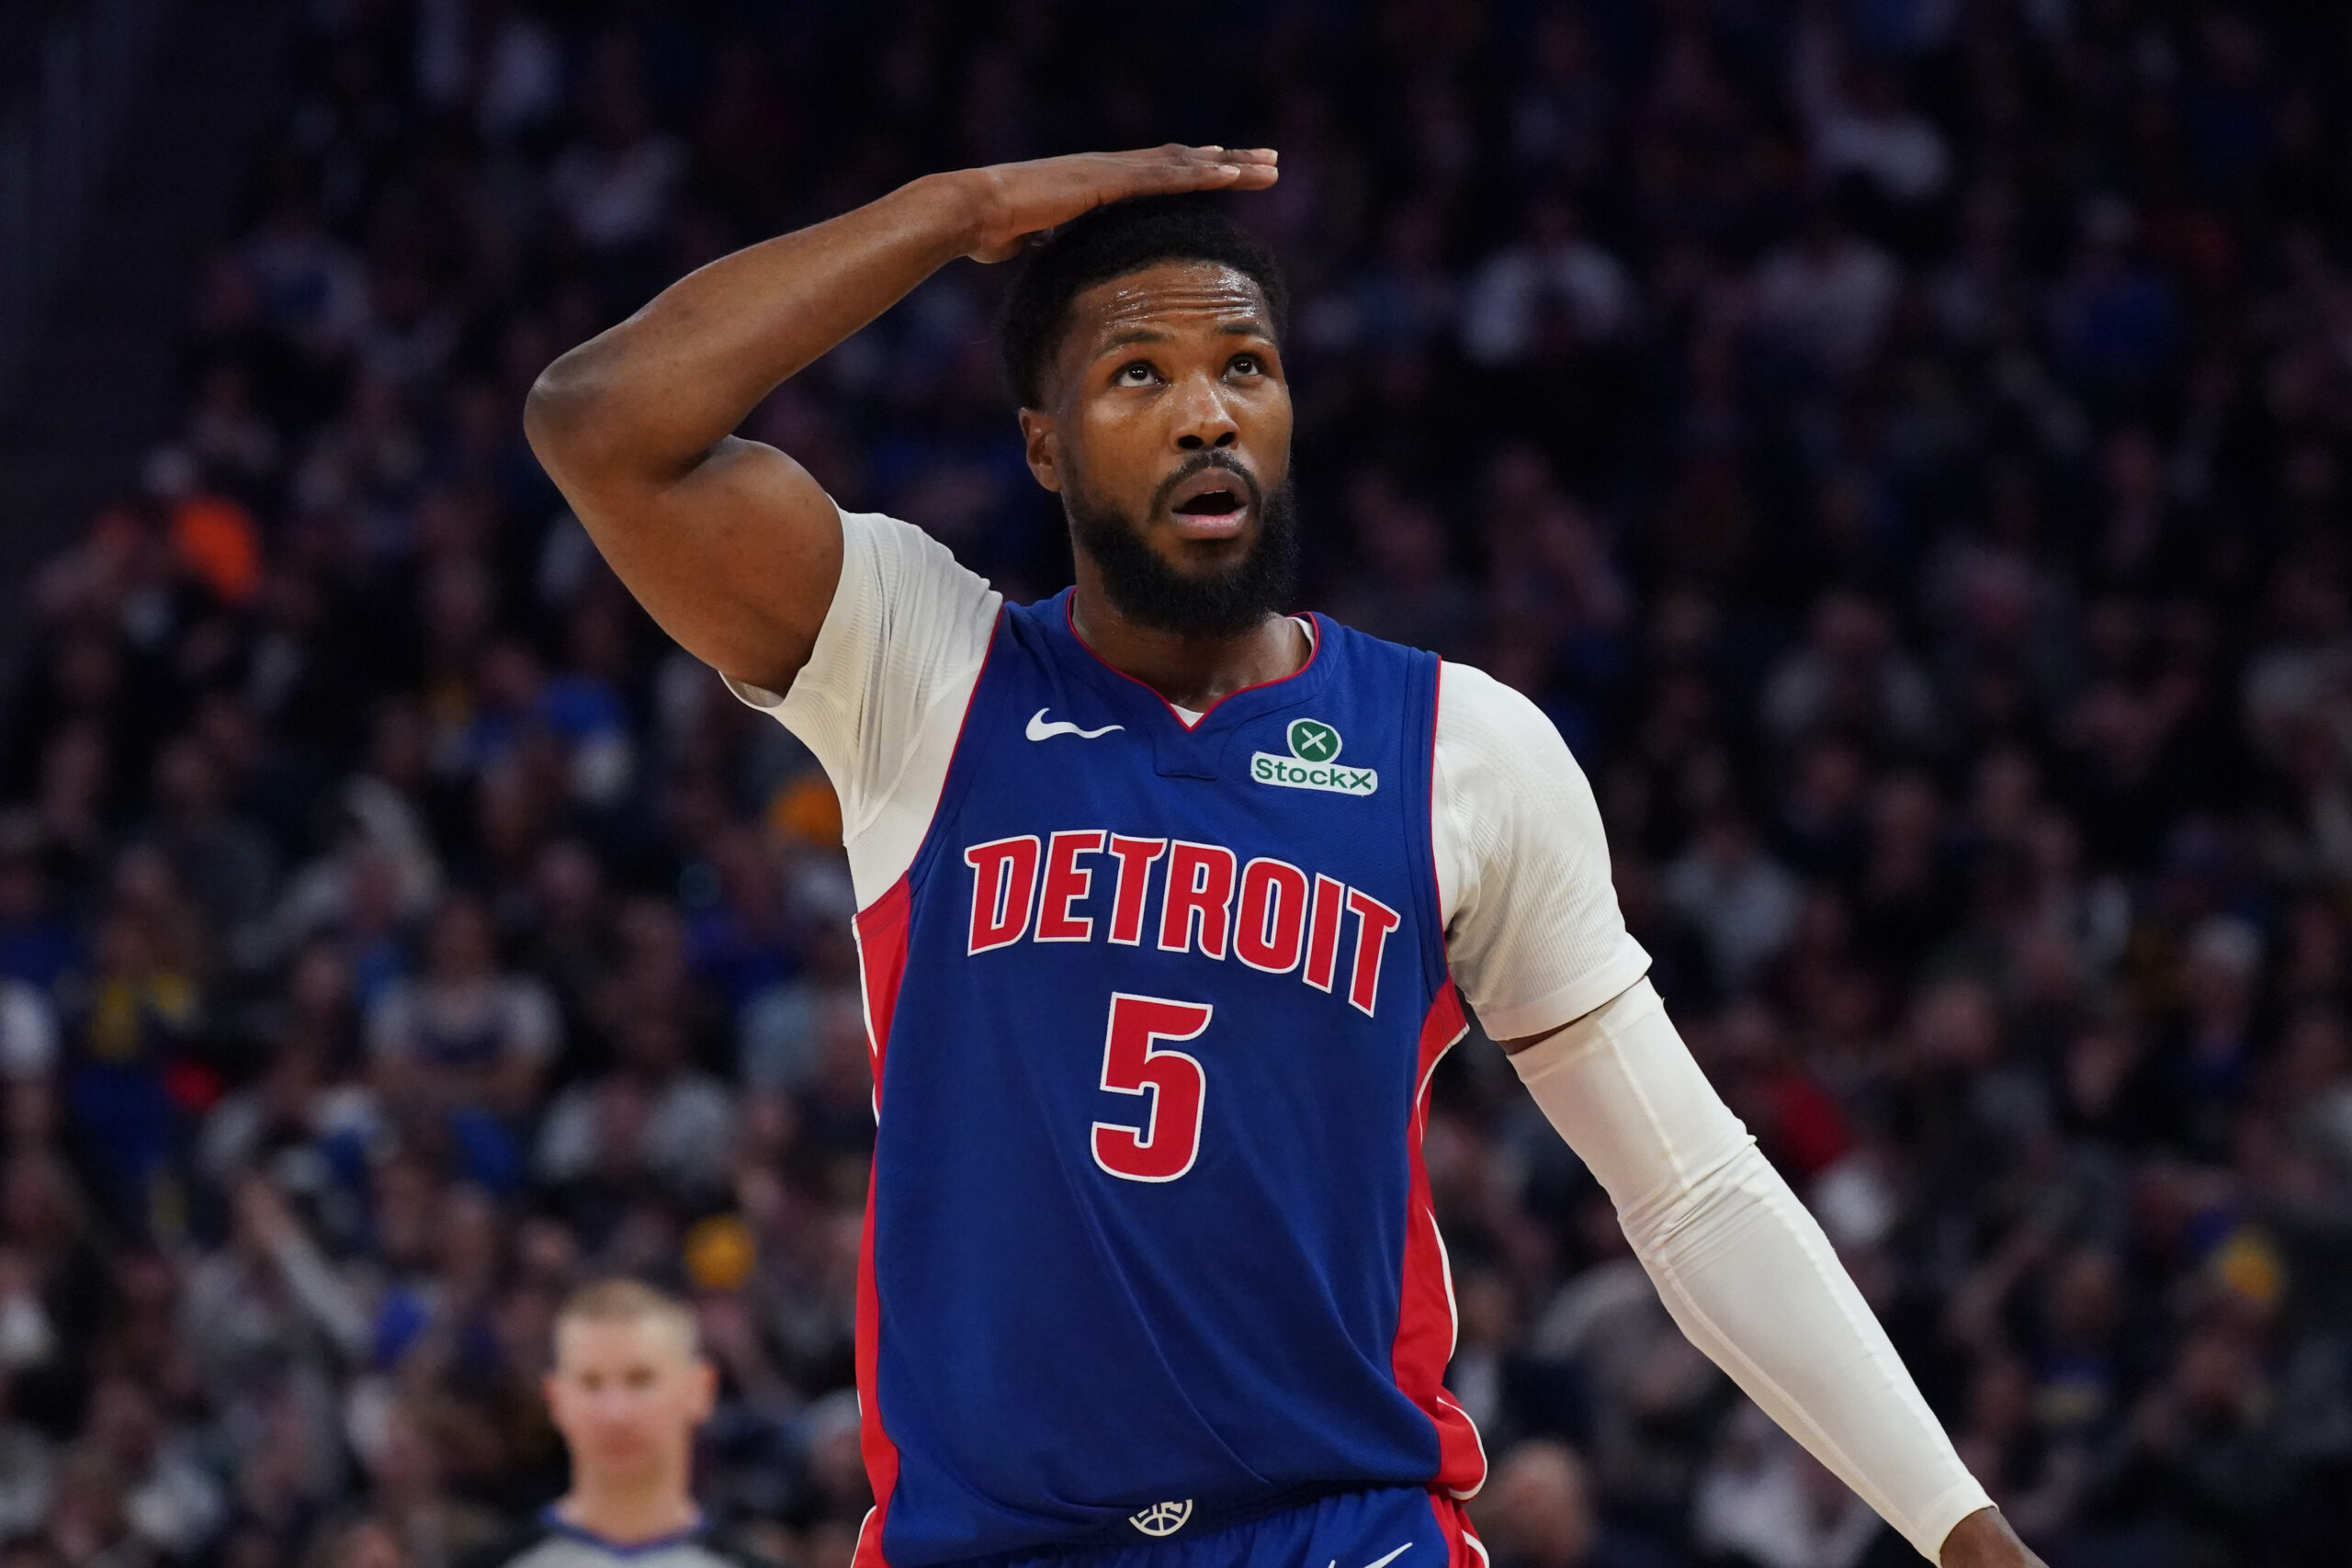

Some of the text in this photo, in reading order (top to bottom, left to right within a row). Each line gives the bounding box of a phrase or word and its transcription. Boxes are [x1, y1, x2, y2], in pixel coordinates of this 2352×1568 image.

[1255, 758, 1372, 790] StockX
[964, 829, 1401, 1018] DETROIT
[1091, 992, 1213, 1182] 5
